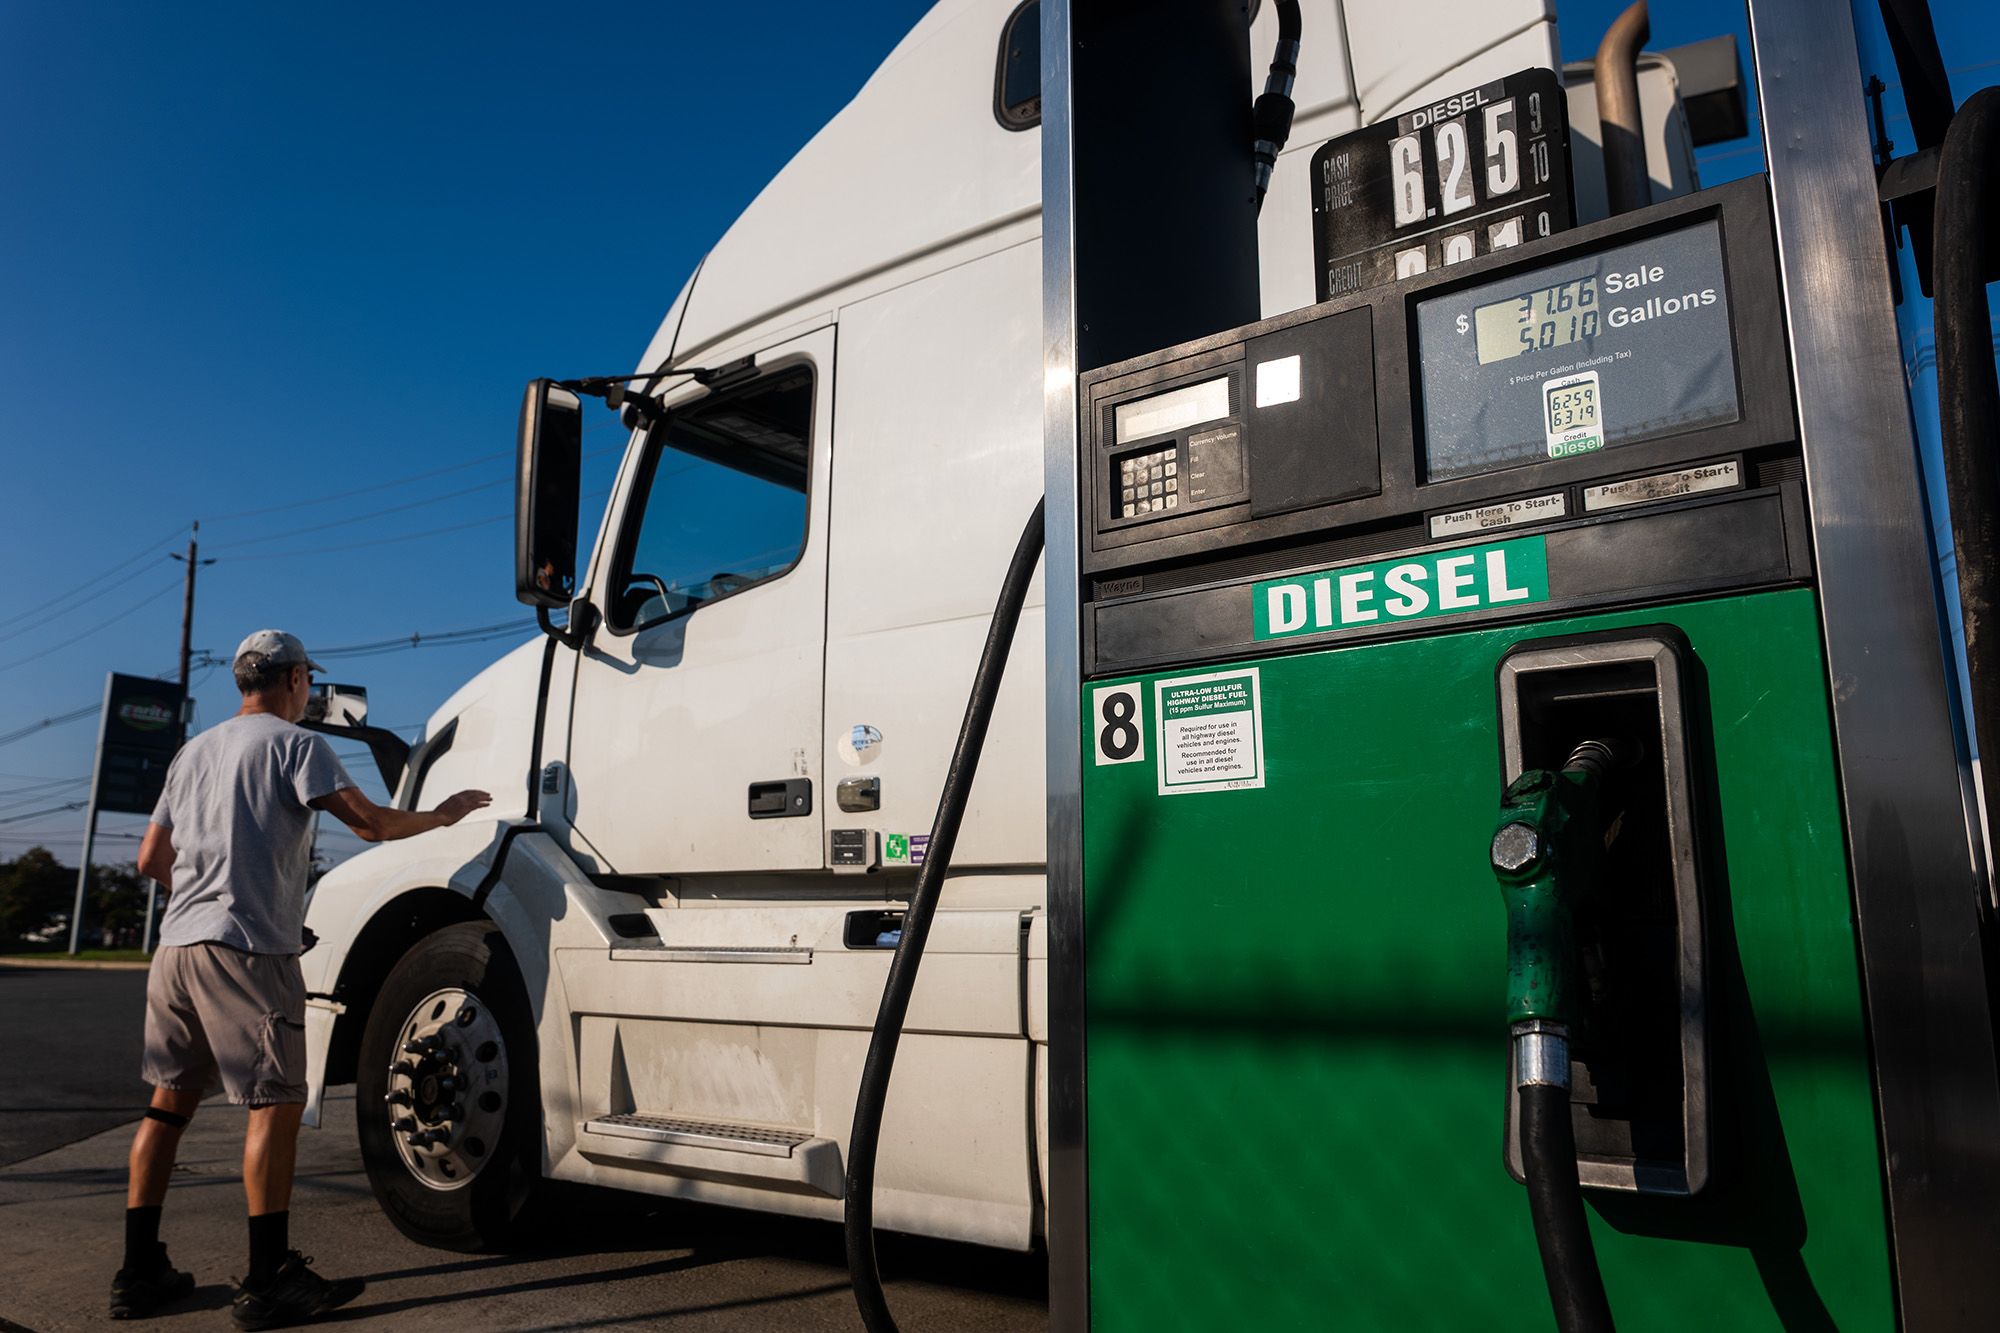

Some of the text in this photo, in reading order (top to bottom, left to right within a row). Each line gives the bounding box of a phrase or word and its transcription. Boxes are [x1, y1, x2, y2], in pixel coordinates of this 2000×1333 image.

[1412, 89, 1489, 130] DIESEL
[1323, 152, 1350, 185] CASH
[1391, 99, 1518, 224] 6.25
[1529, 141, 1550, 185] 10
[1324, 180, 1353, 212] PRICE
[1328, 261, 1363, 296] CREDIT
[1605, 265, 1665, 294] Sale
[1607, 288, 1717, 328] Gallons
[1455, 313, 1470, 336] $
[1519, 310, 1598, 355] 5.010
[1515, 374, 1535, 384] Price
[1535, 370, 1549, 379] Per
[1549, 364, 1575, 376] Gallon
[1575, 354, 1614, 370] (Including
[1614, 349, 1632, 360] Tax)
[1552, 389, 1593, 411] 6.259
[1553, 405, 1594, 427] 6.319
[1552, 435, 1601, 457] Diesel
[1563, 431, 1587, 442] Credit
[1694, 464, 1734, 480] Start-
[1444, 496, 1560, 524] Push Here To Start-
[1480, 515, 1511, 528] Cash
[1267, 549, 1529, 634] DIESEL
[1166, 690, 1248, 707] HIGHWAY DIESEL FUEL
[1171, 683, 1243, 698] ULTRA-LOW SULFUR
[1169, 699, 1247, 715] (15 ppm Sulfur Maximum)
[1100, 691, 1140, 761] 8
[1180, 724, 1208, 733] Required
[1190, 732, 1216, 741] highway
[1216, 729, 1236, 737] diesel
[1176, 740, 1201, 749] vehicles
[1215, 737, 1242, 745] engines.
[1181, 749, 1227, 759] Recommended
[1177, 766, 1203, 775] vehicles
[1216, 763, 1243, 772] engines.
[1214, 755, 1234, 763] diesel
